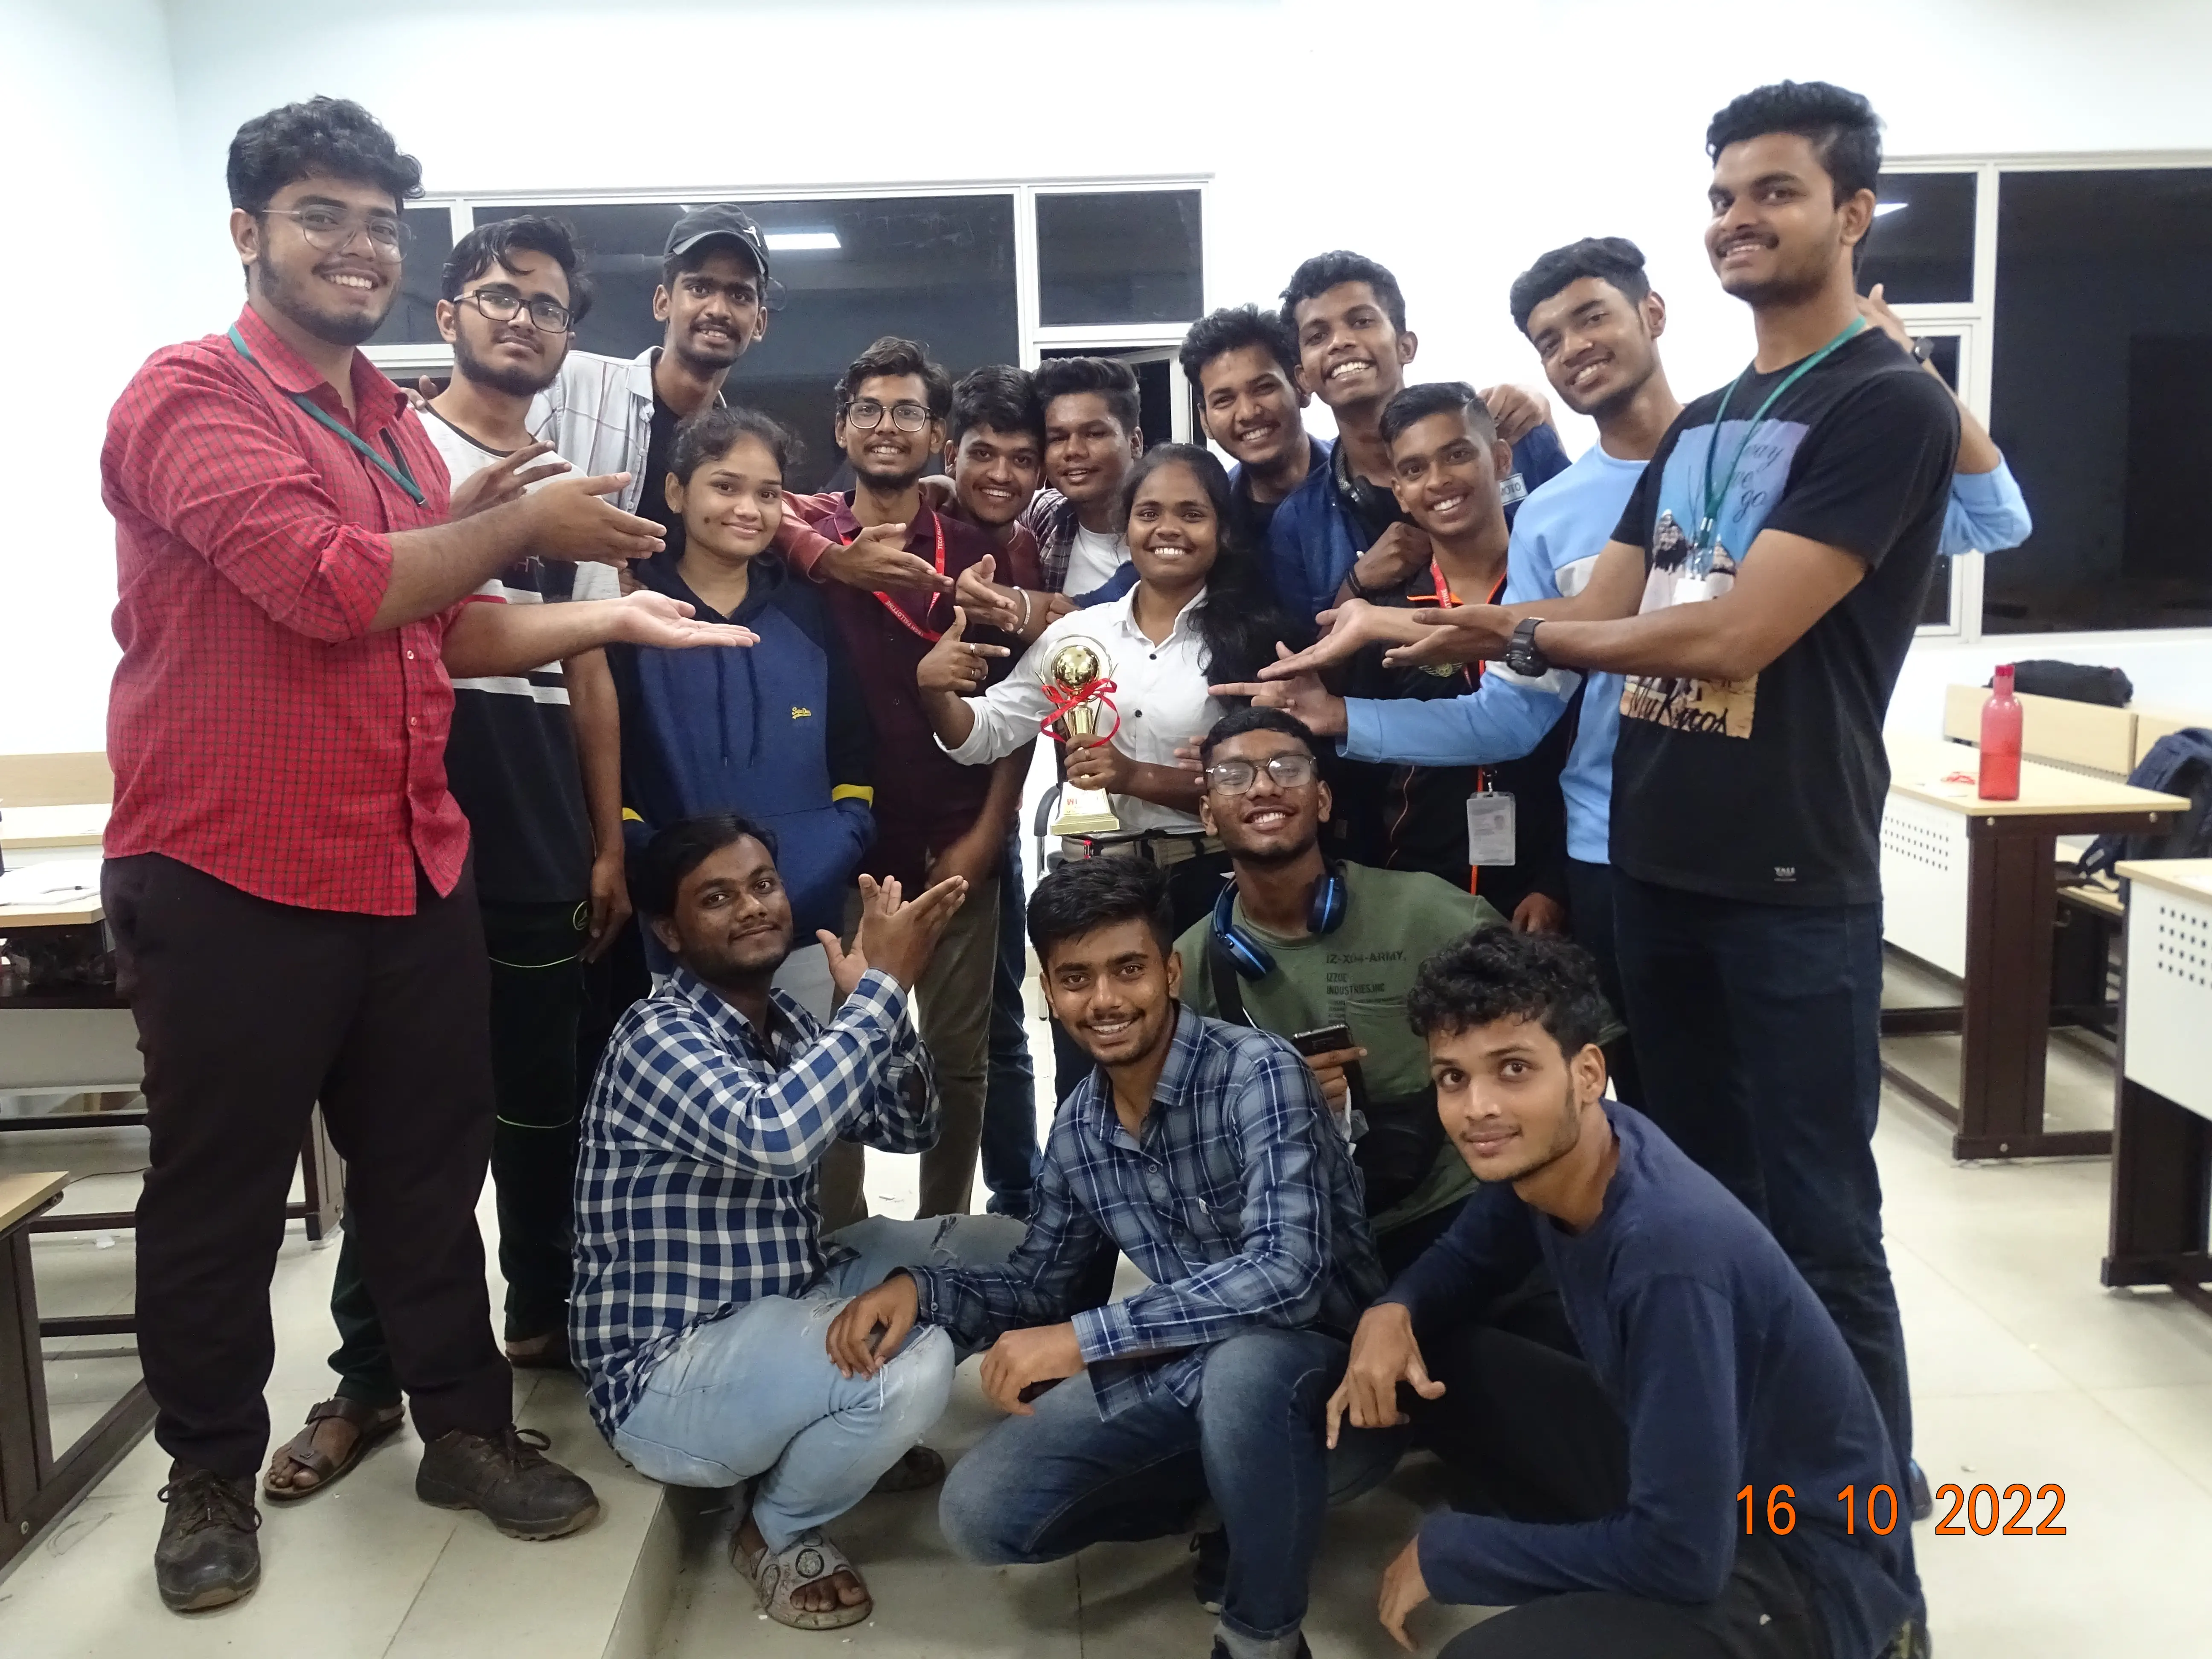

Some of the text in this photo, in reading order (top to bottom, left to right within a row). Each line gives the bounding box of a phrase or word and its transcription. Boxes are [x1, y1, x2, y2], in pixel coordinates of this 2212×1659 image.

[1733, 490, 1767, 523] go
[885, 600, 924, 637] TECH PALLOTTINE
